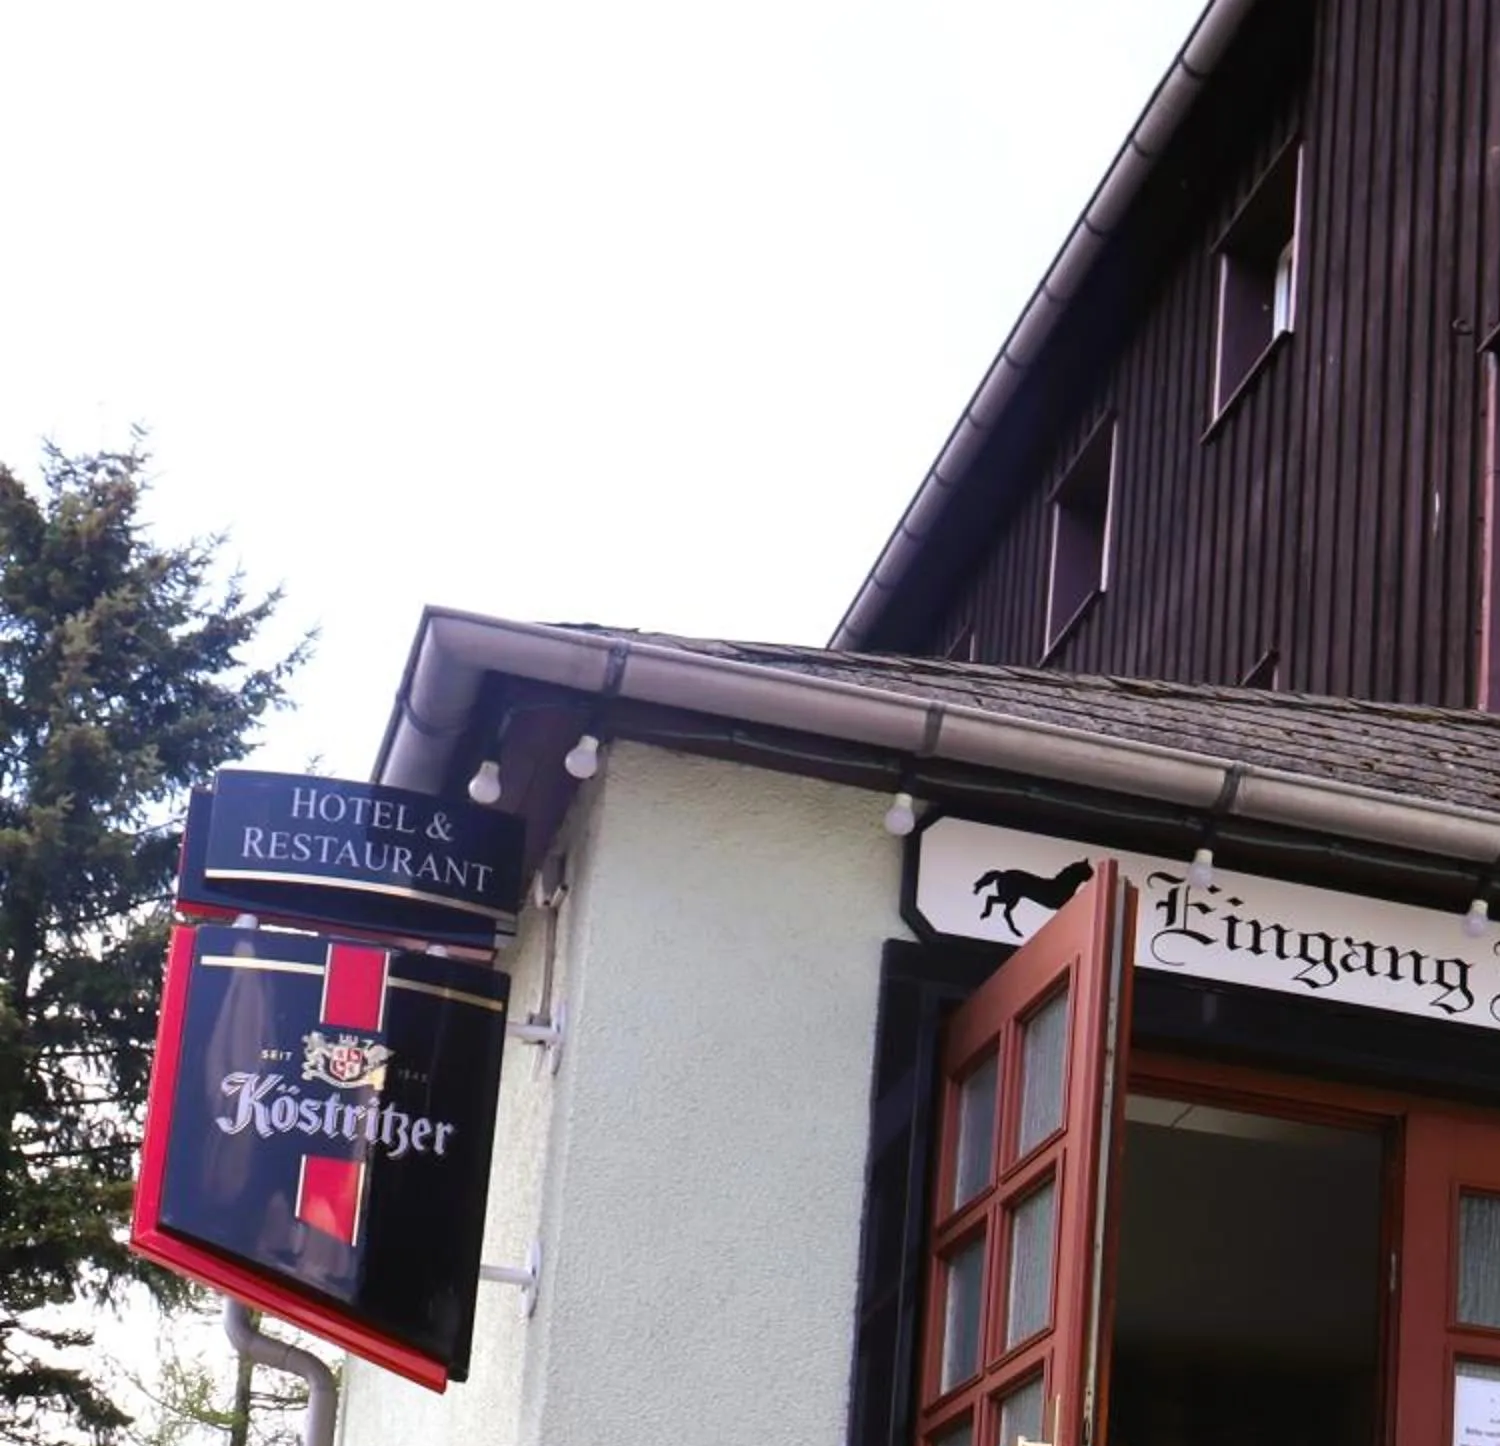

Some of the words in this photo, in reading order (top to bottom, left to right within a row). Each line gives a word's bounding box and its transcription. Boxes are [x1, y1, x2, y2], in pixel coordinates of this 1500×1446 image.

[290, 786, 416, 834] HOTEL
[425, 811, 454, 842] &
[240, 826, 493, 893] RESTAURANT
[1146, 871, 1476, 1014] Eingang
[260, 1049, 294, 1061] SEIT
[215, 1071, 455, 1159] Köstritzer
